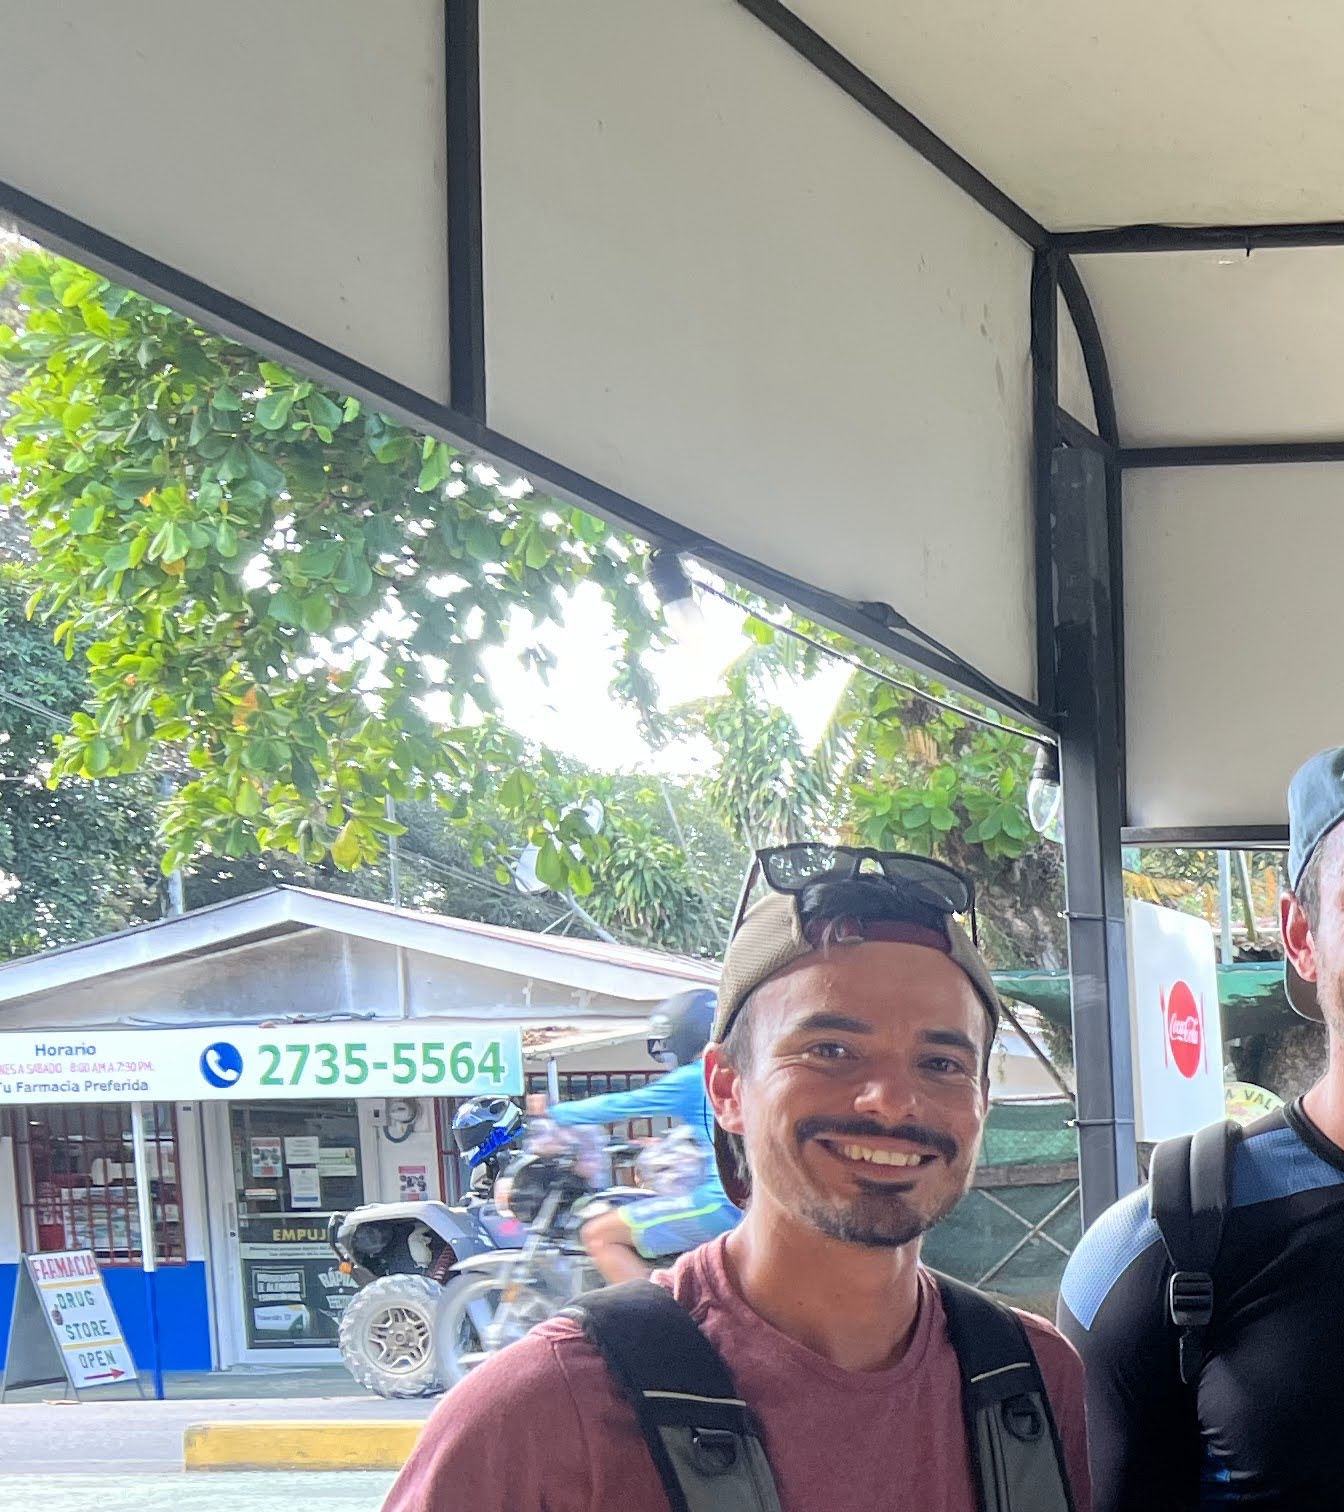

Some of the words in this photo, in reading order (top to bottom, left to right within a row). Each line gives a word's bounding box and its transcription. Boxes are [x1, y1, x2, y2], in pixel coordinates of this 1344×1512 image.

[35, 1042, 97, 1057] Horario
[257, 1041, 505, 1086] 2735-5564
[16, 1080, 80, 1093] Farmacia
[84, 1078, 149, 1092] Preferida
[31, 1254, 97, 1281] FARMACIA
[56, 1290, 96, 1310] DRUG
[65, 1320, 111, 1340] STORE
[78, 1350, 117, 1369] OPEN
